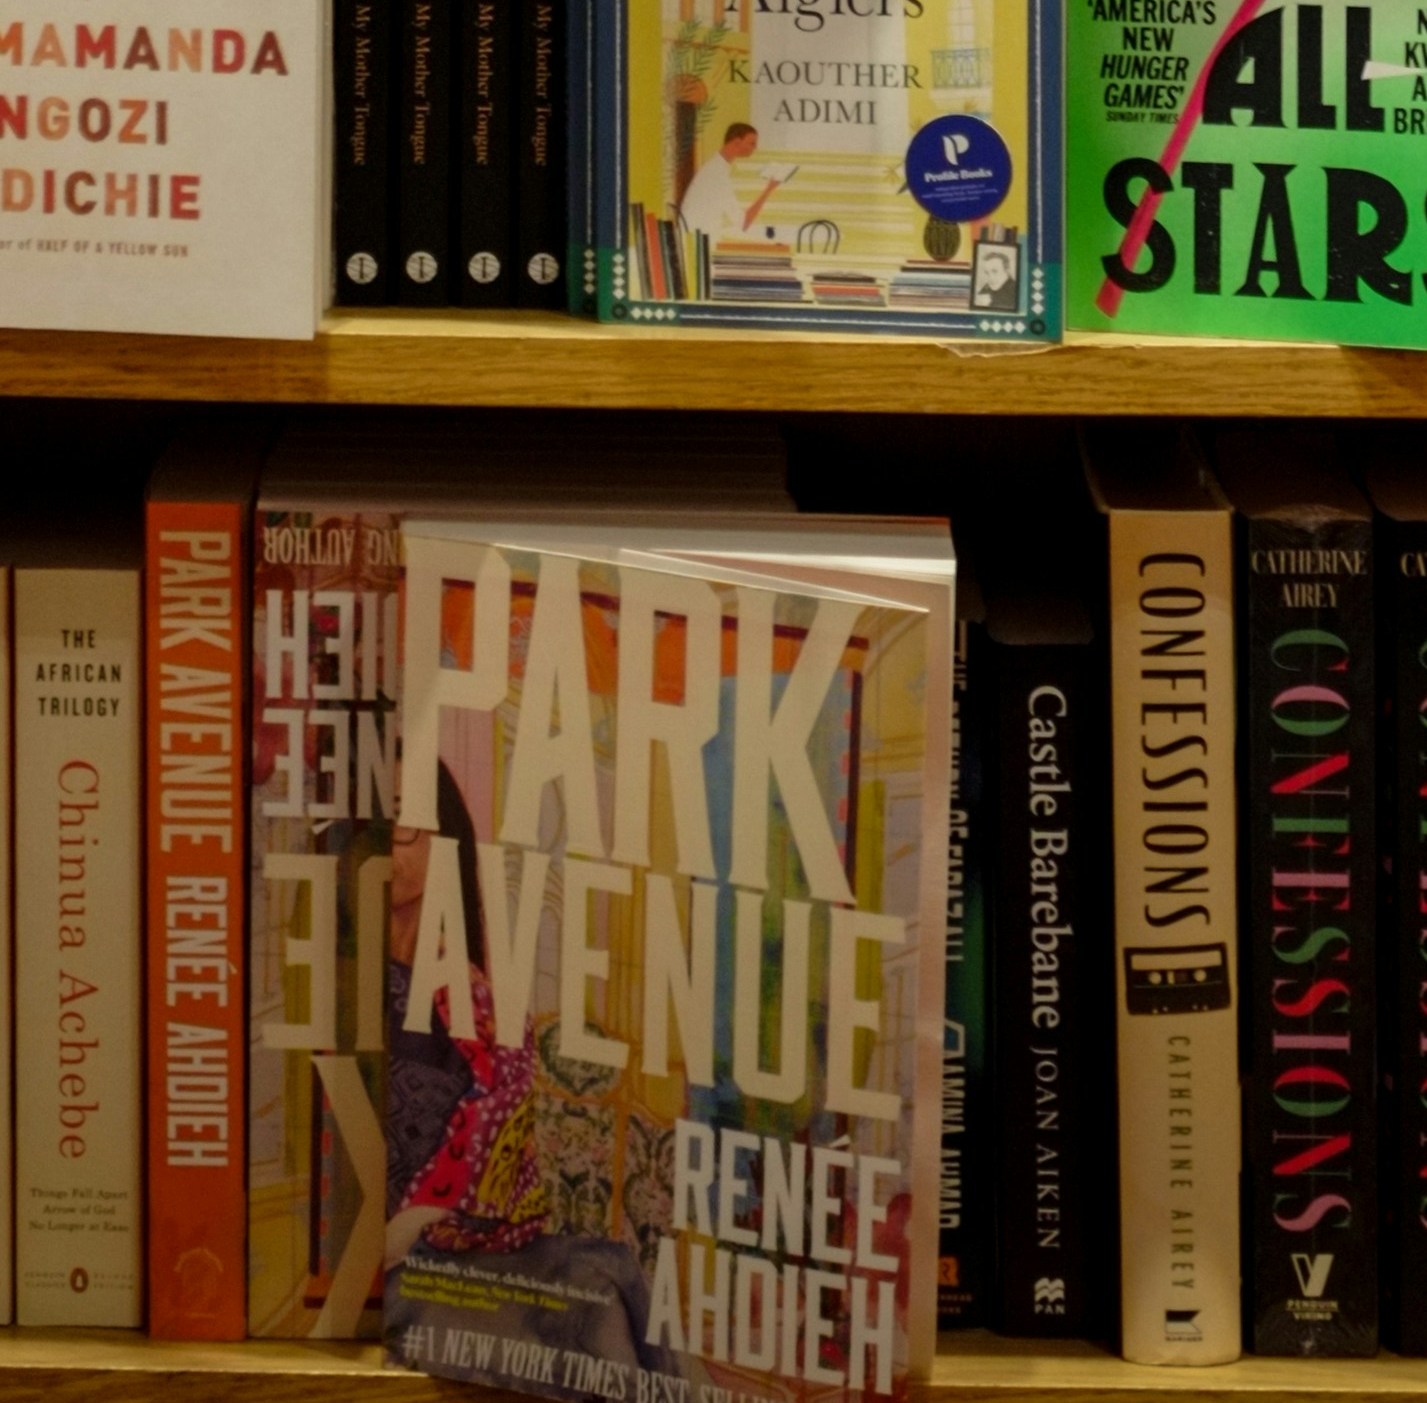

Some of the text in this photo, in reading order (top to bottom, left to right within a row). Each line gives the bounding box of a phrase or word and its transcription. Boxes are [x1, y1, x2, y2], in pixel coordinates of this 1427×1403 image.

[728, 59, 924, 90] KAOUTHER
[1100, 55, 1189, 82] HUNGER
[1104, 84, 1185, 110] GAMES'
[1123, 27, 1175, 52] NEW
[1203, 3, 1385, 133] ALL
[774, 99, 878, 125] ADIMI
[37, 663, 124, 685] AFRICAN
[61, 629, 97, 650] THE
[38, 698, 121, 720] TRILOGY
[398, 538, 858, 906] PARK
[1140, 554, 1210, 929] CONFESSIONS
[158, 529, 238, 1170] PARK AVENUE RENÉE AHDIEH
[1029, 685, 1075, 1030] Castle Barebane
[58, 760, 100, 1162] Chinua Achebe
[403, 835, 908, 1121] AVENUE
[673, 1118, 902, 1273] RENÉE
[645, 1238, 898, 1397] AHDIEH
